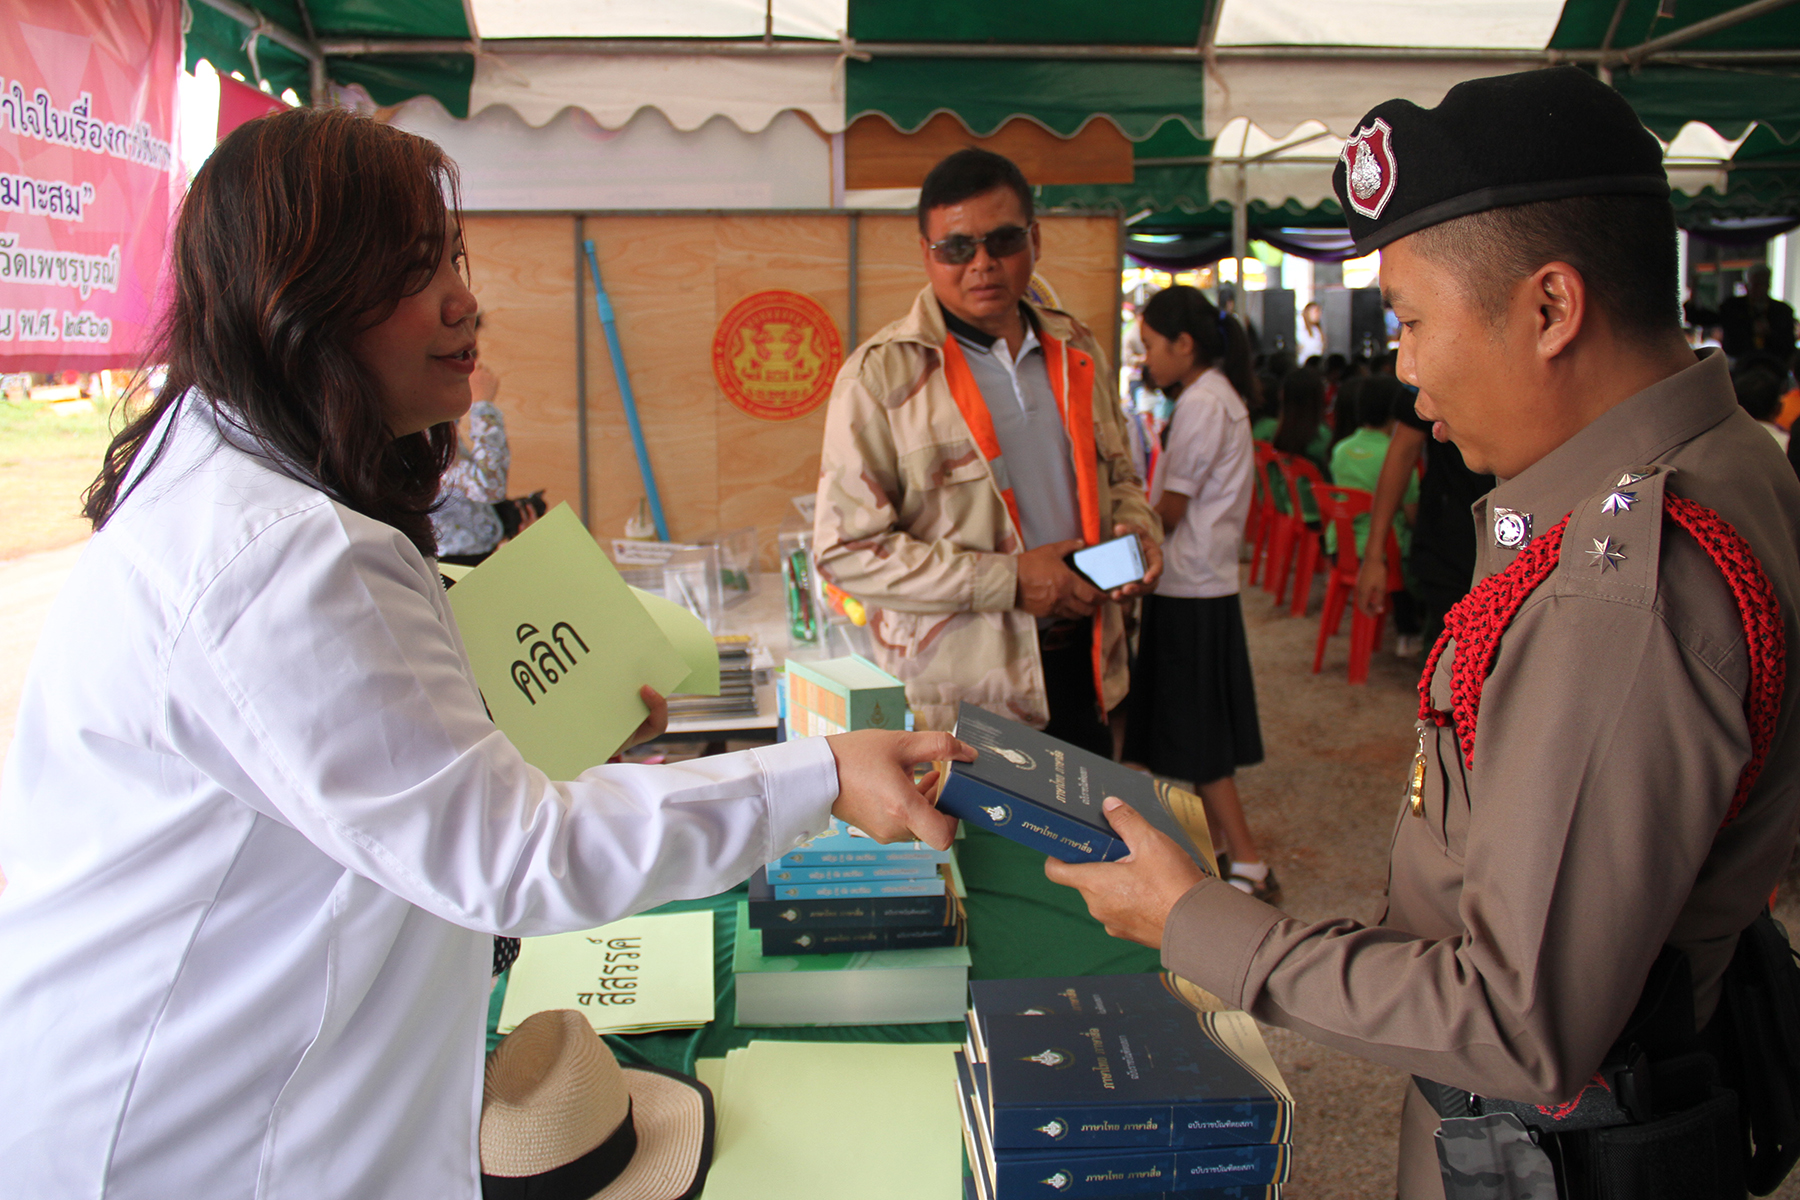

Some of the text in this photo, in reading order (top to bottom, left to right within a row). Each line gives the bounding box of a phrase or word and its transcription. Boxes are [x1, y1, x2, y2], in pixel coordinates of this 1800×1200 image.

[511, 621, 590, 706] คลิก
[1021, 821, 1093, 854] ภาษาไทย ภาษาสื่อ
[576, 936, 642, 1006] สีสรรค์
[1081, 1120, 1120, 1132] ภาษาไทย
[1123, 1117, 1159, 1132] ภาษาสื่อ
[1085, 1170, 1125, 1183] ภาษาไทย
[1127, 1165, 1162, 1179] ภาษาสื่อ
